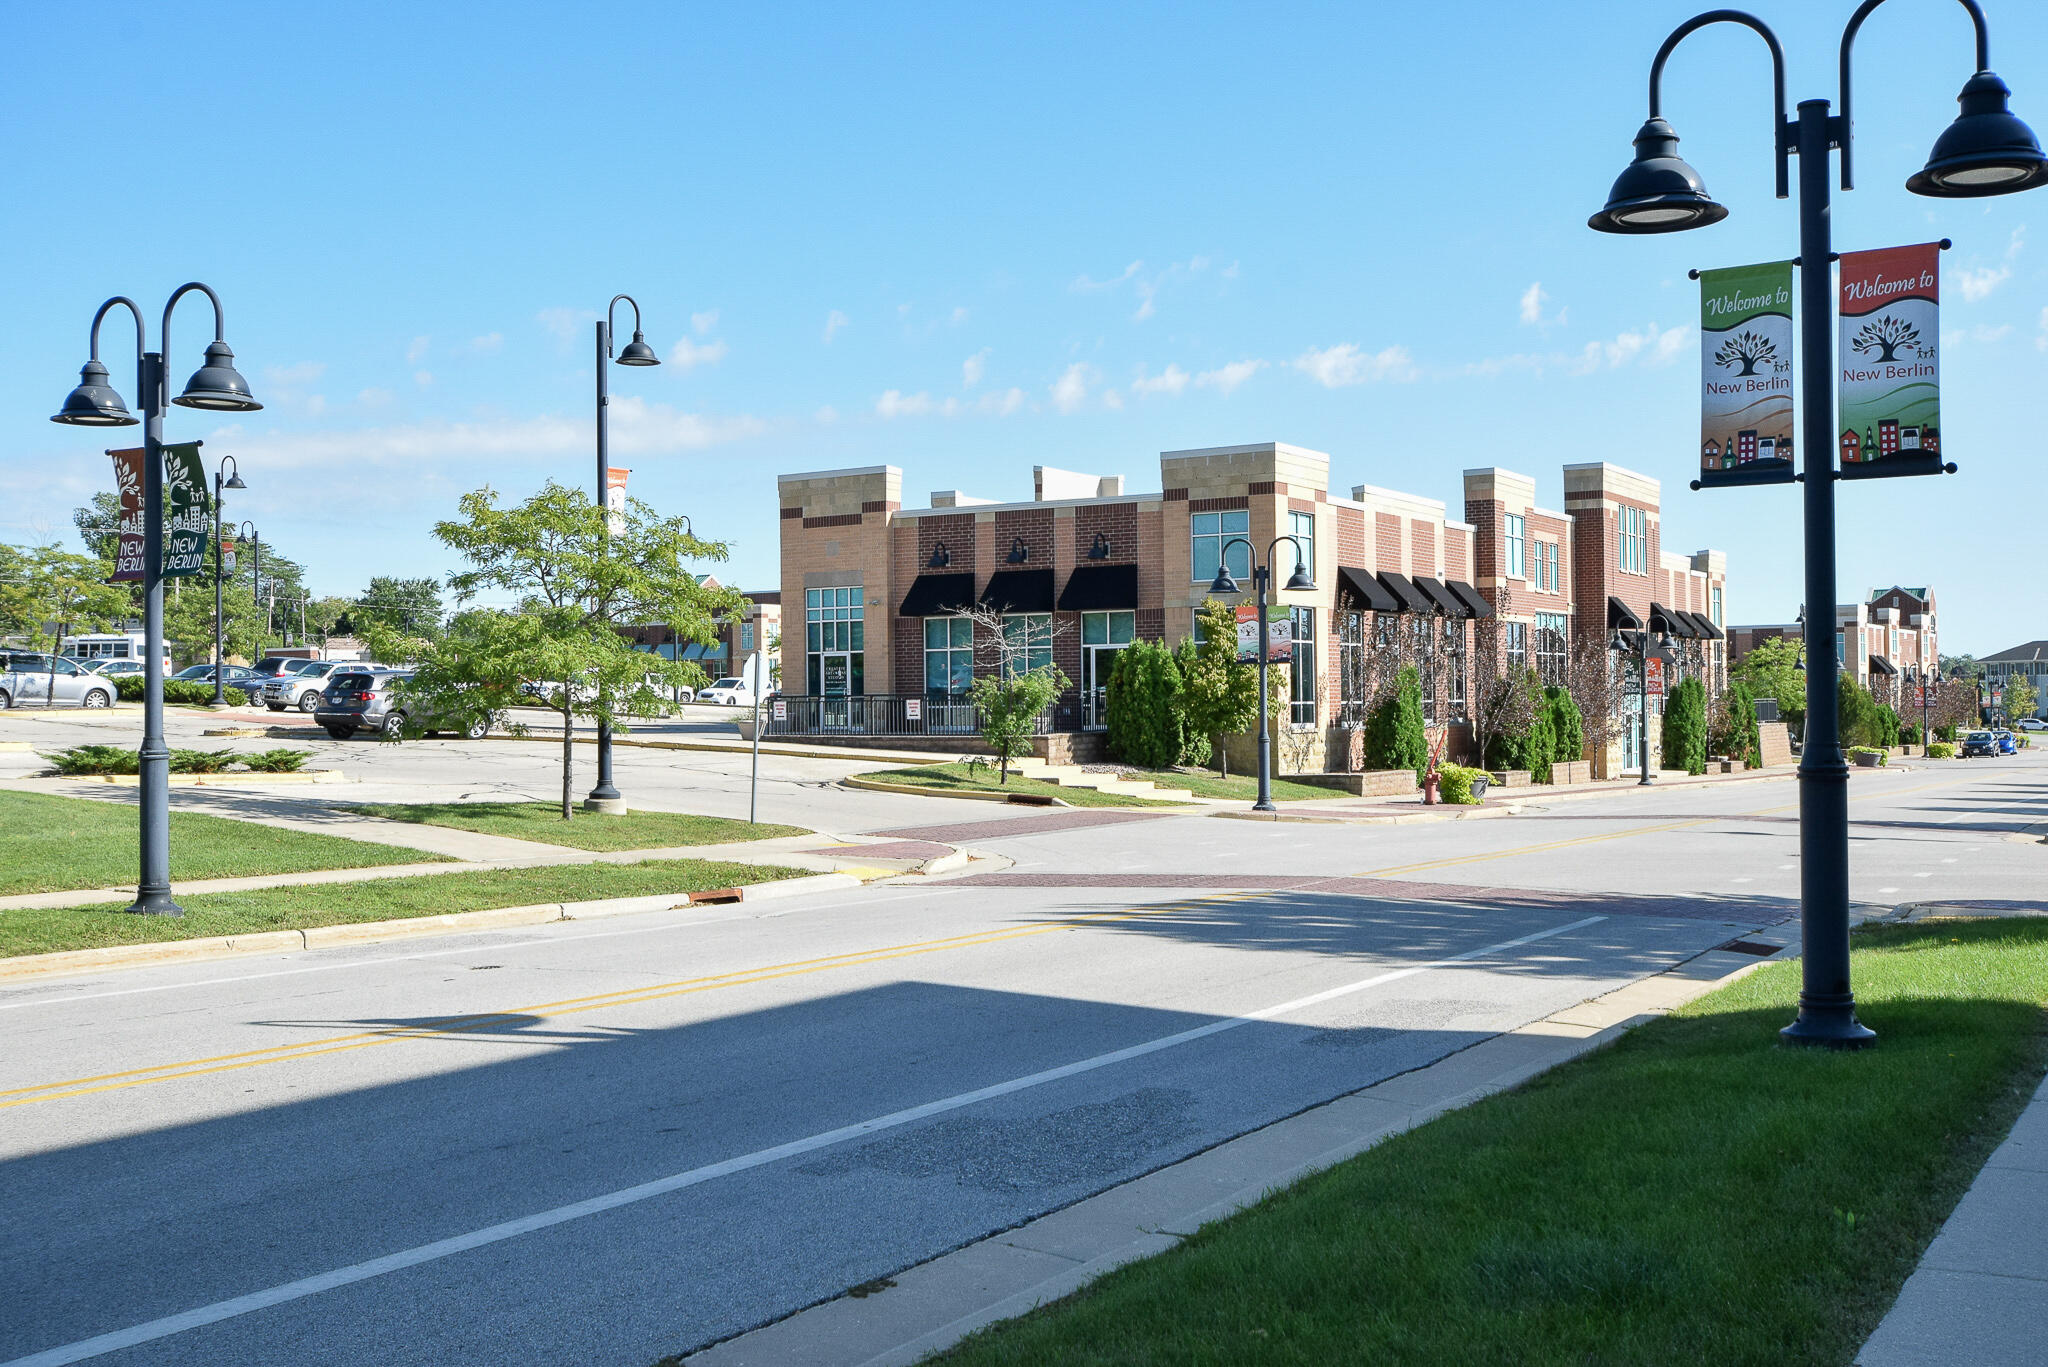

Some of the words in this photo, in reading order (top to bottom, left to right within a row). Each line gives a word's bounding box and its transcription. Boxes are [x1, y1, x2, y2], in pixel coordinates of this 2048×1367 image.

[1844, 273, 1916, 301] Welcome
[1920, 269, 1934, 288] to
[1706, 289, 1772, 316] Welcome
[1776, 286, 1789, 304] to
[1843, 368, 1881, 382] New
[1886, 363, 1935, 379] Berlin
[1706, 382, 1742, 395] New
[1746, 376, 1790, 392] Berlin
[120, 541, 145, 557] NEW
[171, 537, 198, 554] NEW
[116, 557, 145, 572] BERLI
[167, 553, 203, 570] BERLIN
